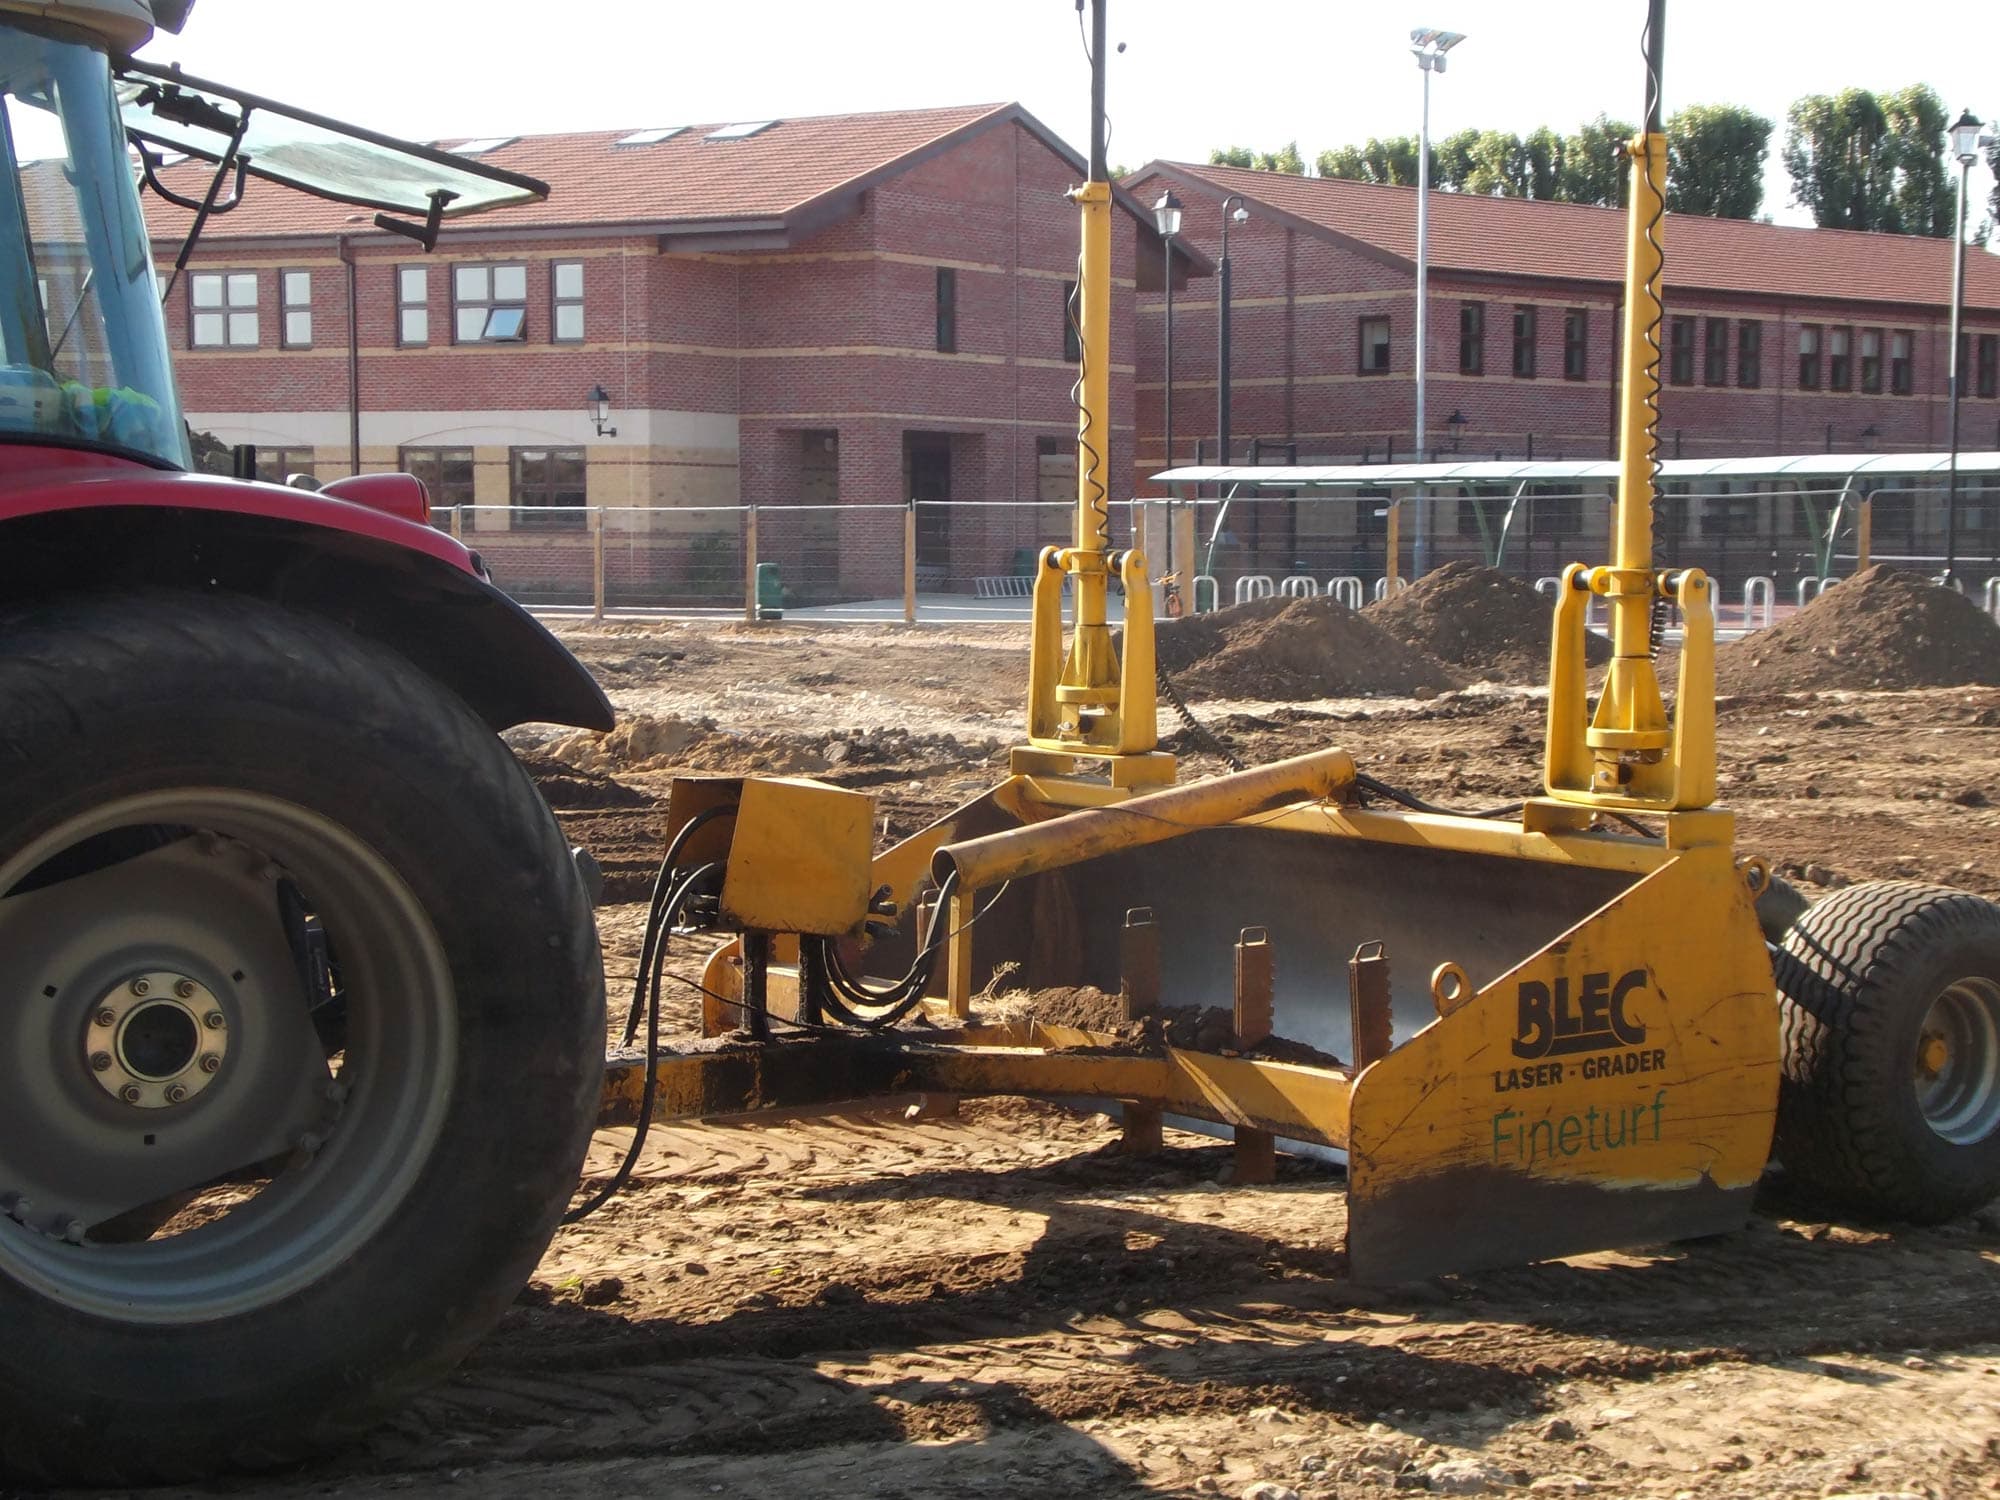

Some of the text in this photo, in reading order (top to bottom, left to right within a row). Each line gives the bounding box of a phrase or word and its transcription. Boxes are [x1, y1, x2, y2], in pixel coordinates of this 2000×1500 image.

[1511, 970, 1647, 1059] BLEC
[1495, 1049, 1666, 1092] LASER GRADER
[1494, 1090, 1667, 1162] Fineturf
